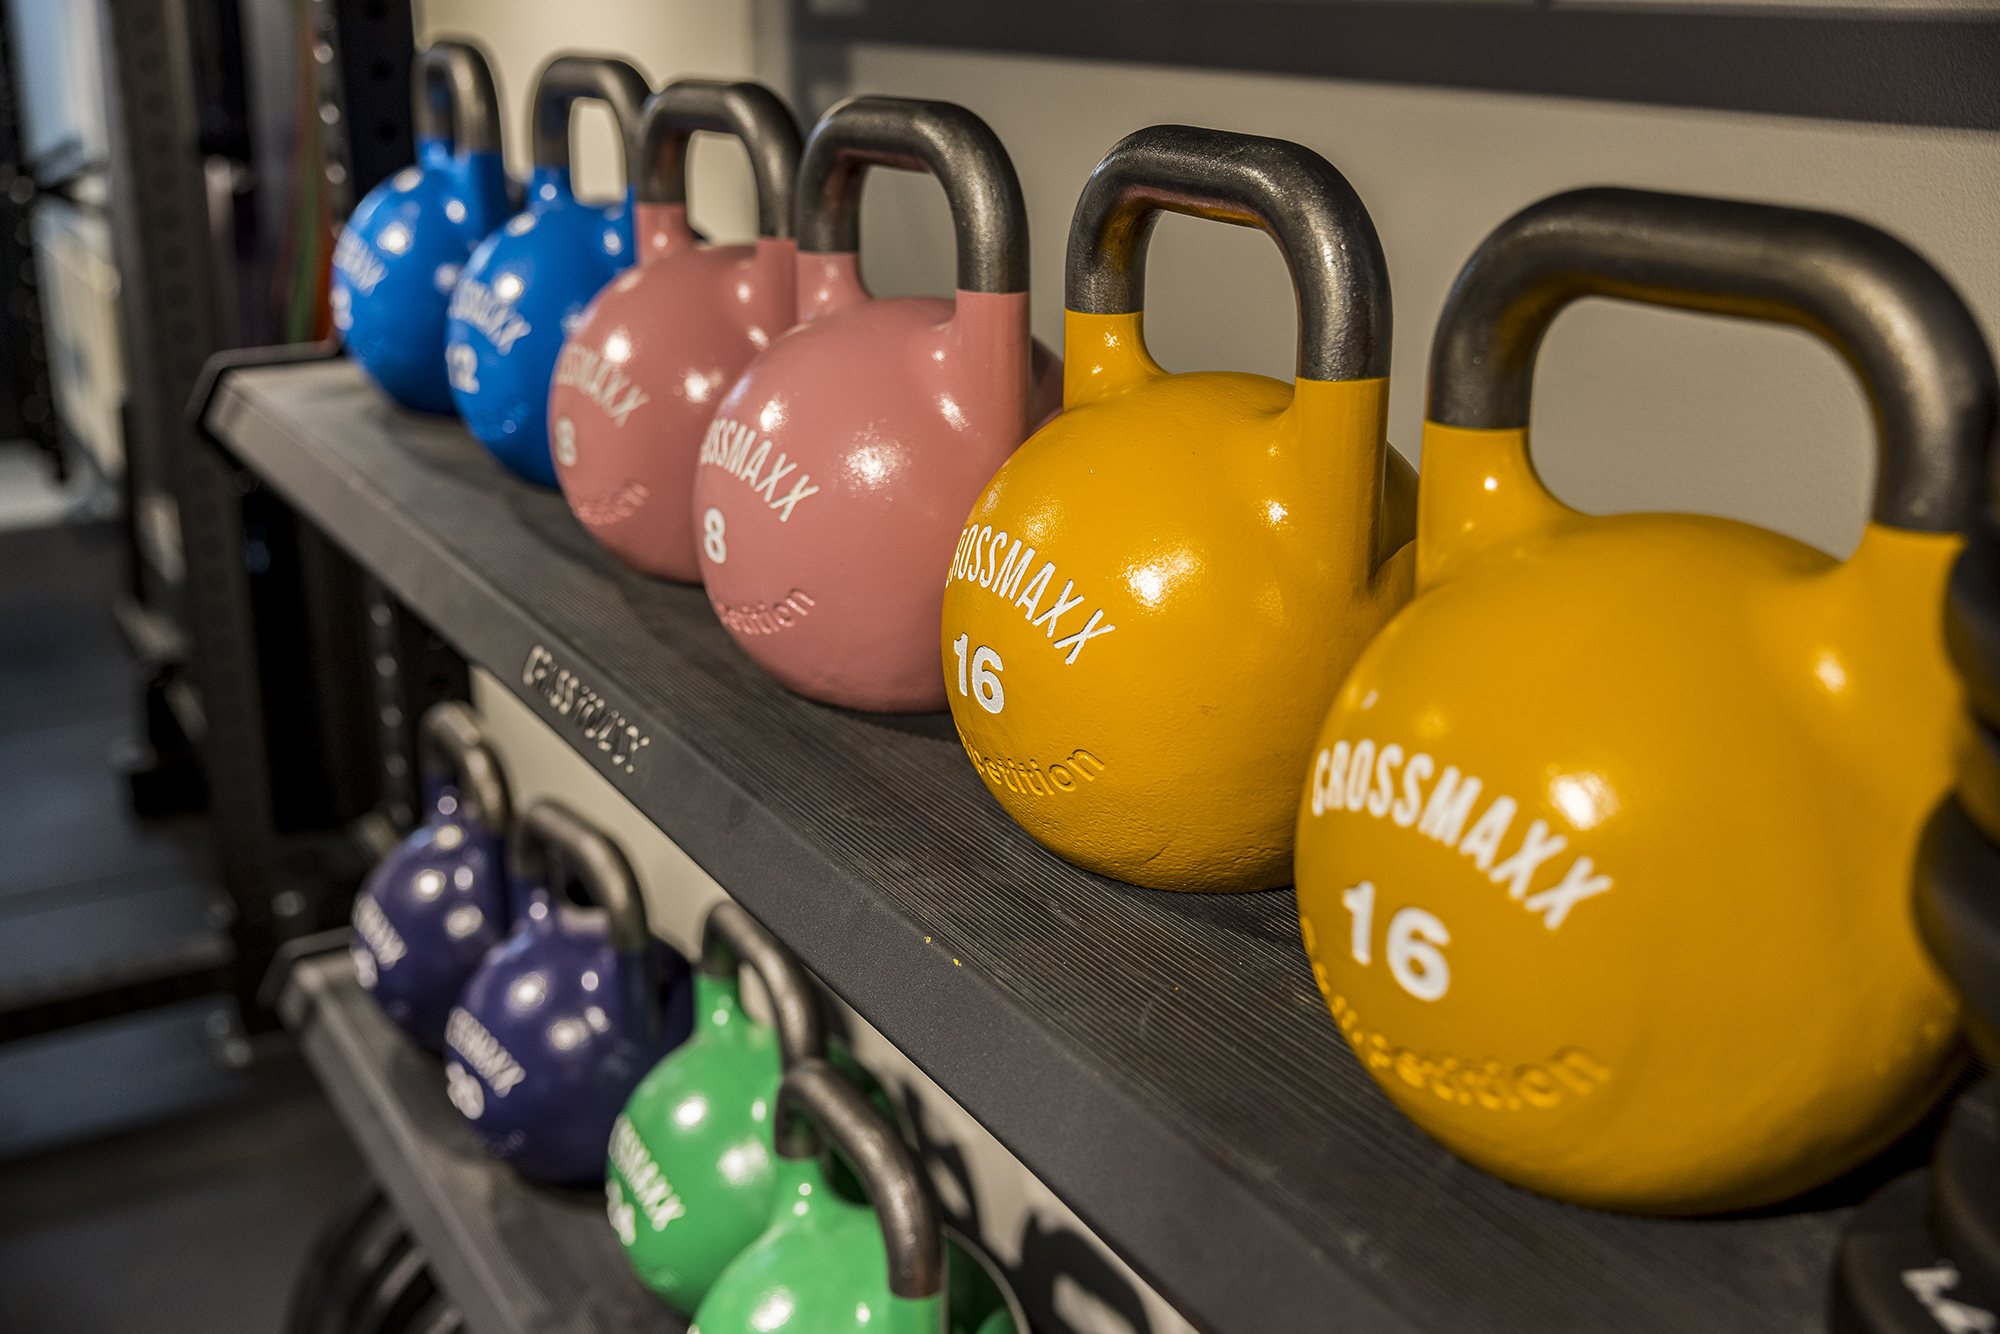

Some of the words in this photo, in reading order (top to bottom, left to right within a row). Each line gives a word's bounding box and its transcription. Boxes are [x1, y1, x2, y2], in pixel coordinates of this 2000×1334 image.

[703, 507, 727, 564] 8
[953, 632, 1004, 714] 16
[1312, 738, 1614, 931] CROSSMAXX
[1343, 880, 1452, 1002] 16
